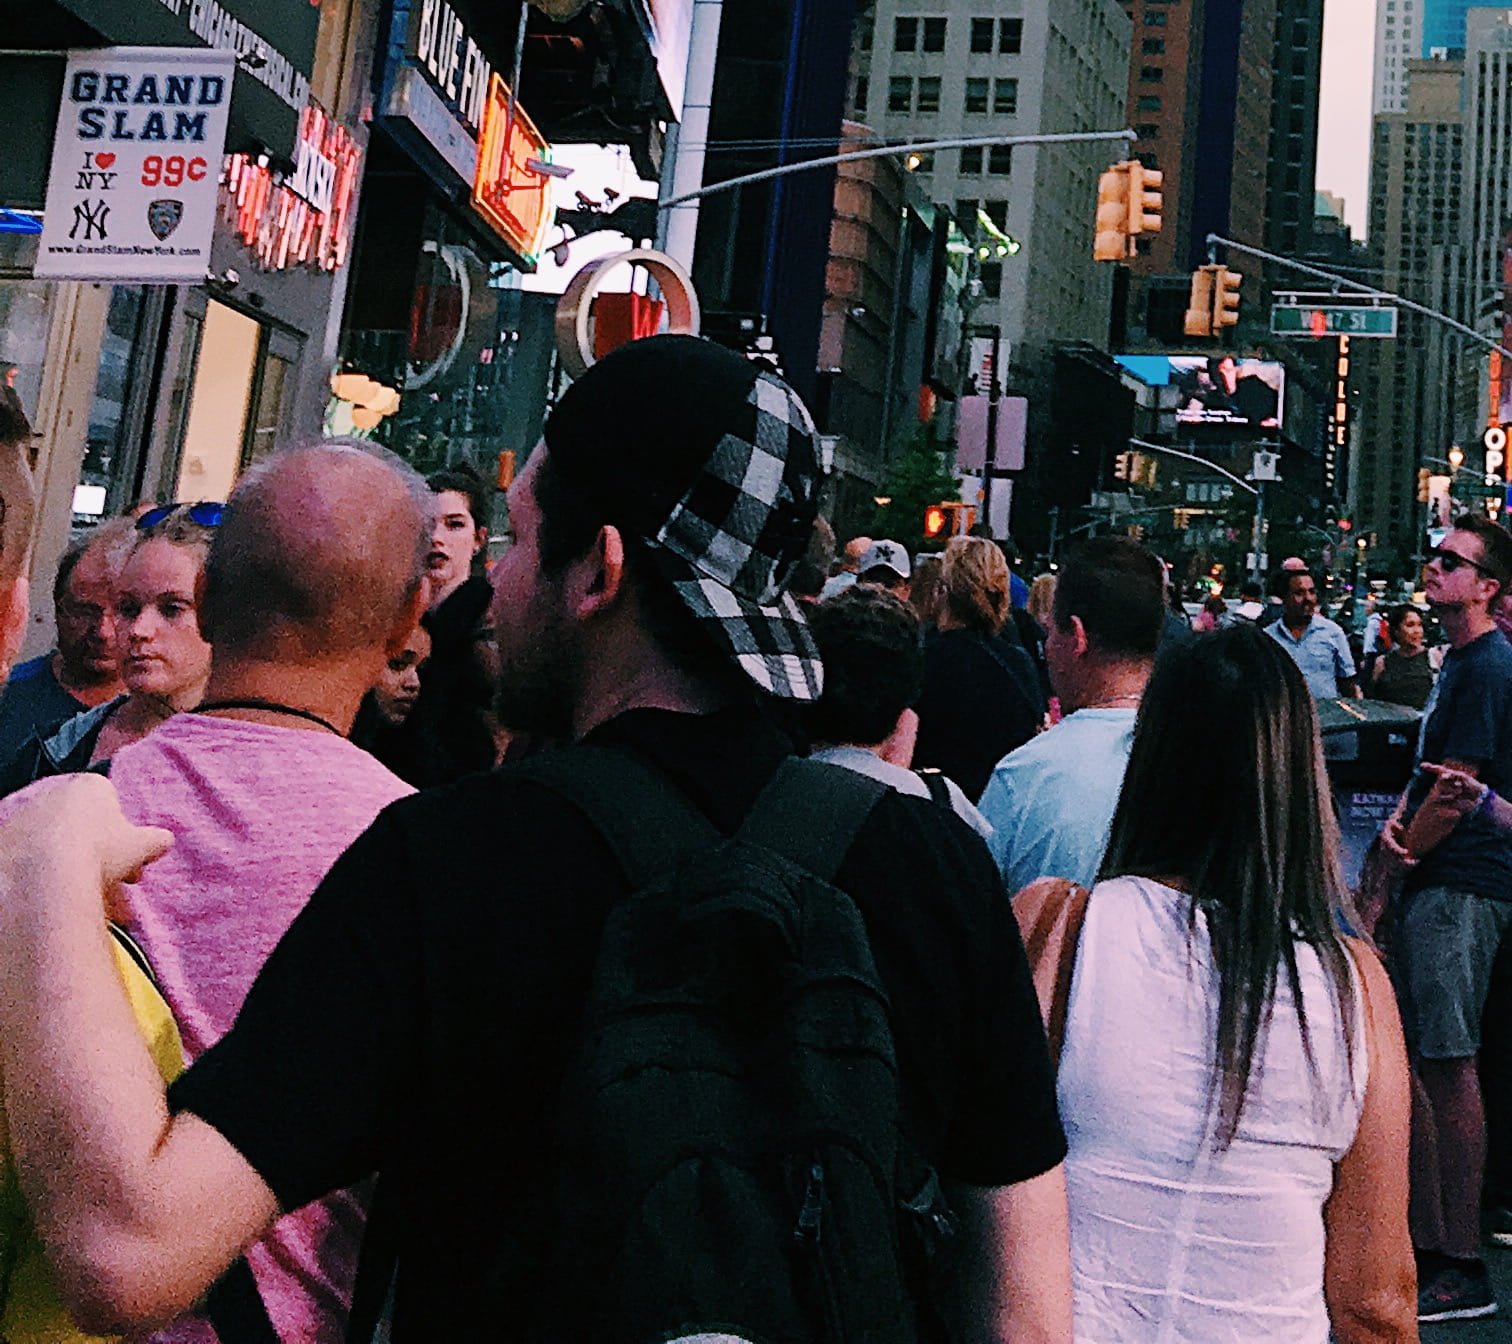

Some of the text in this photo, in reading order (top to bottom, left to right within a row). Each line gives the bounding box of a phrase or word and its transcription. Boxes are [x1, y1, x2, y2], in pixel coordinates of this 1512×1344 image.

[70, 69, 226, 106] GRAND
[78, 107, 208, 143] SLAM
[75, 171, 118, 190] NY
